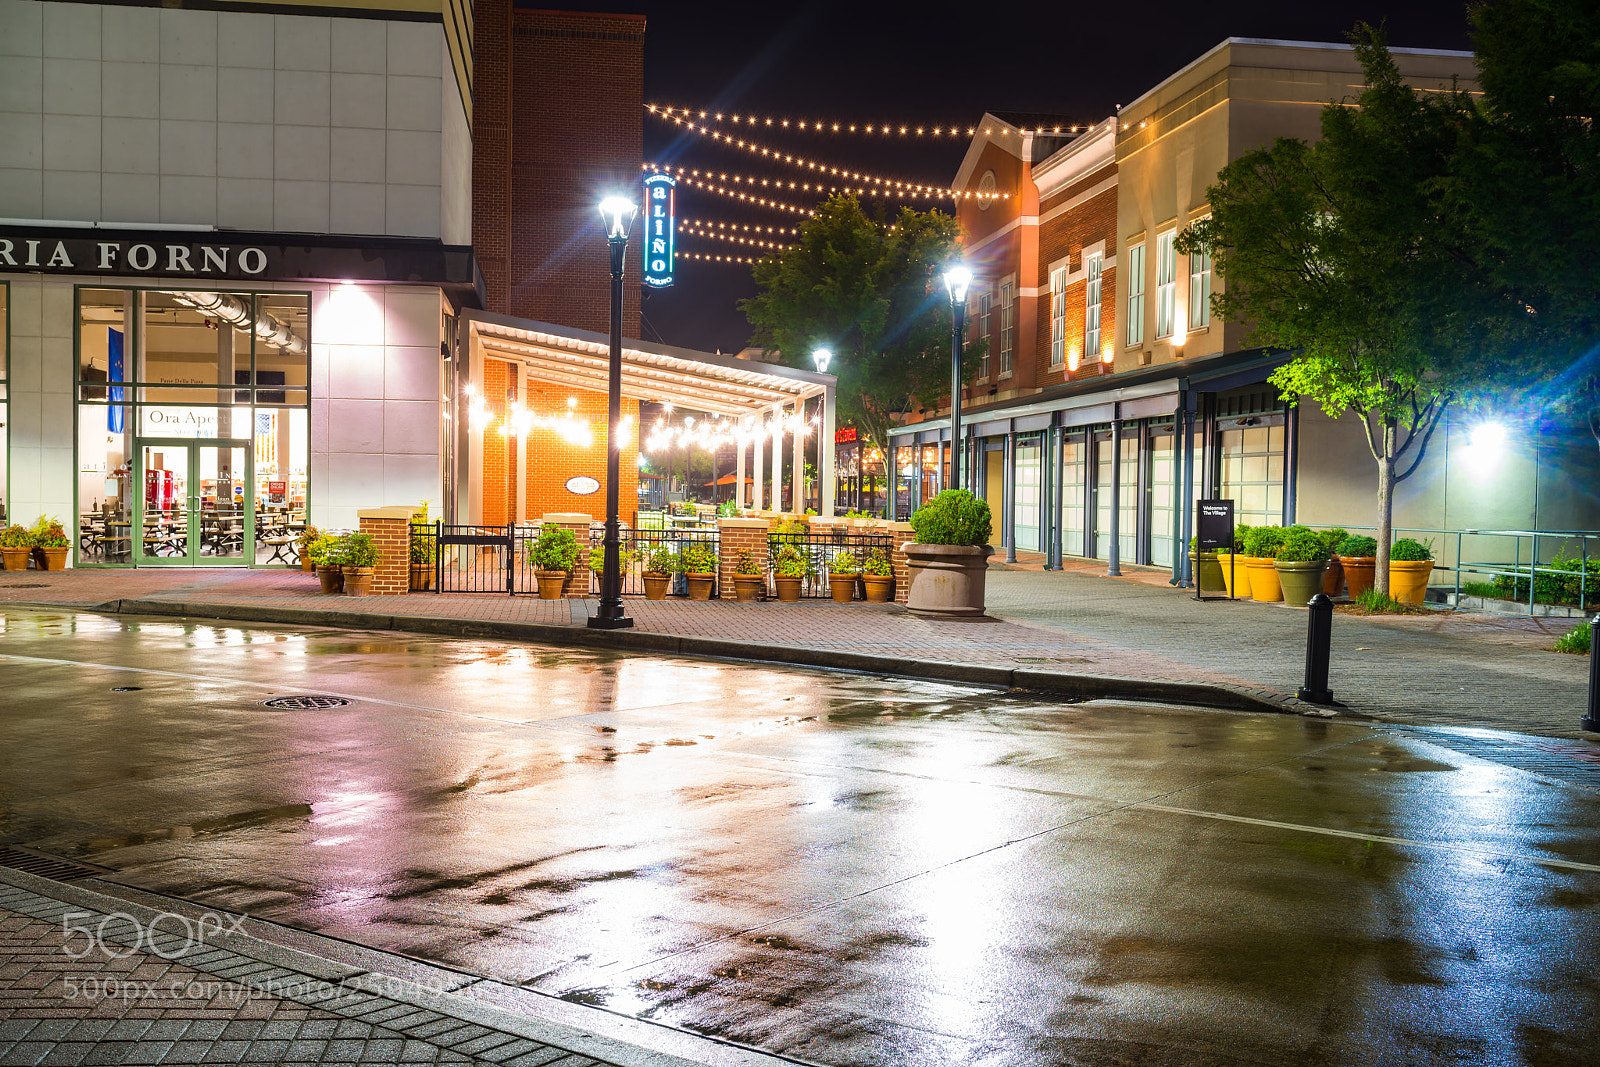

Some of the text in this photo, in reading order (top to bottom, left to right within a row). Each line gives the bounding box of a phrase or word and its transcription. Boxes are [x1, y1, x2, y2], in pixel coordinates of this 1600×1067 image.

[97, 243, 268, 274] FORNO
[644, 275, 673, 285] FORNO
[150, 410, 180, 424] Ora
